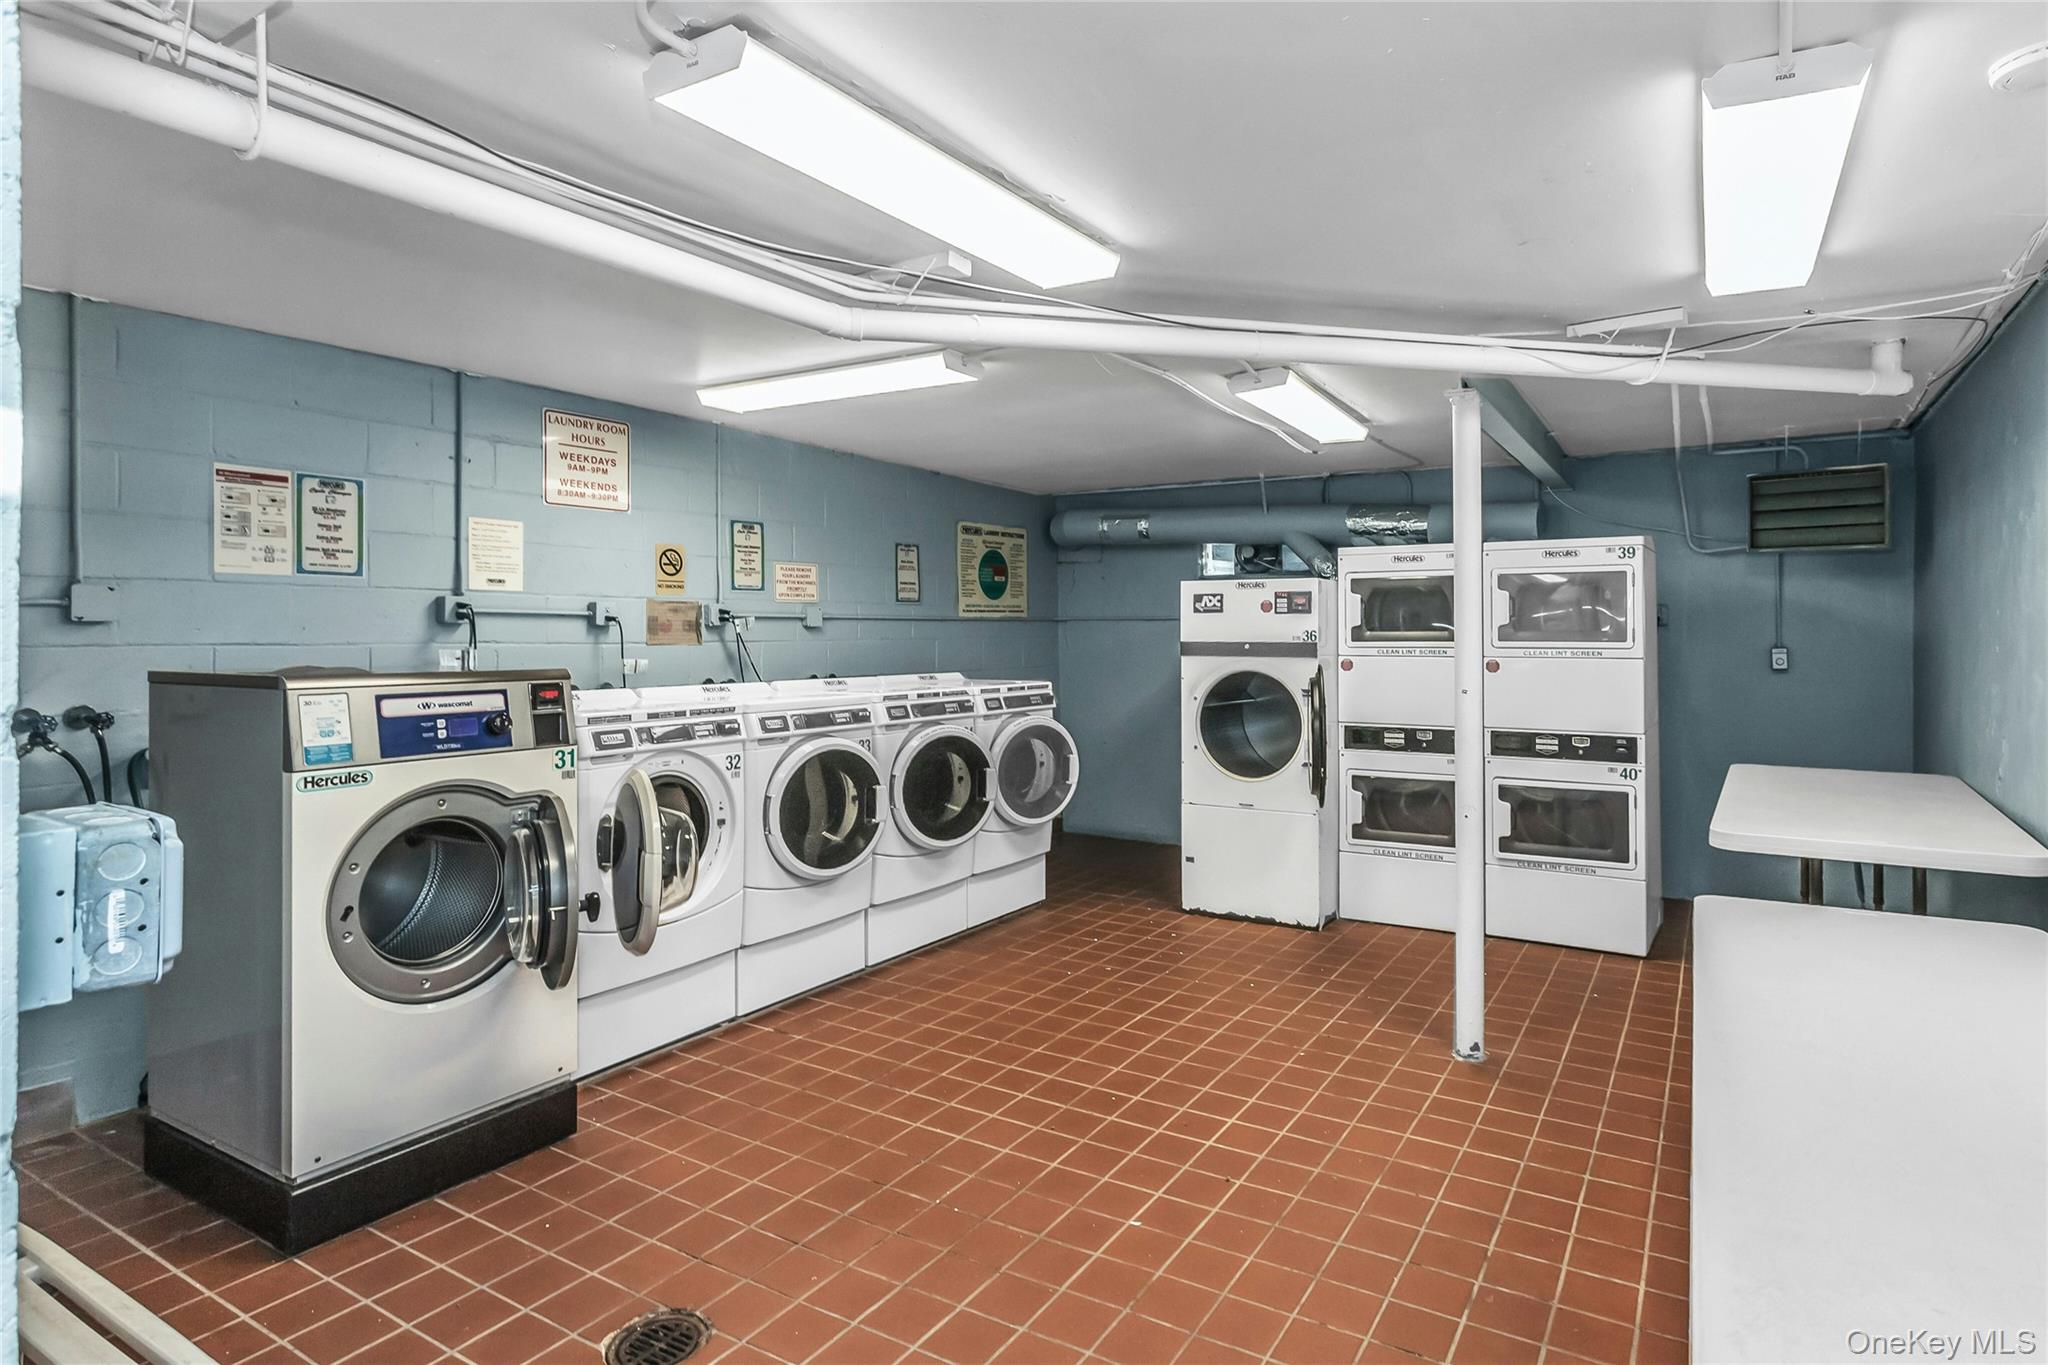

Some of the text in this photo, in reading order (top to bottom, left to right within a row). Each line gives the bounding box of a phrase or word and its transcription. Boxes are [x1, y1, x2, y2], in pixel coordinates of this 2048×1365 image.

[548, 413, 627, 436] LAUNDRY ROOM
[571, 433, 606, 446] HOURS
[559, 451, 617, 467] WEEKDAYS
[560, 478, 618, 492] WEEKENDS
[1393, 554, 1423, 562] Hercules
[1544, 550, 1578, 558] Hercules
[1617, 546, 1636, 559] 39
[1236, 581, 1265, 589] Hercules
[1302, 630, 1317, 642] 36
[438, 700, 473, 709] wascomat
[554, 748, 575, 770] 31
[725, 754, 741, 771] 32
[303, 771, 369, 789] Hercules
[1619, 767, 1638, 781] 40
[1373, 848, 1396, 857] CLEAN
[1415, 853, 1444, 861] SCREEN
[1518, 861, 1597, 875] CLEAN LINT SCREEN
